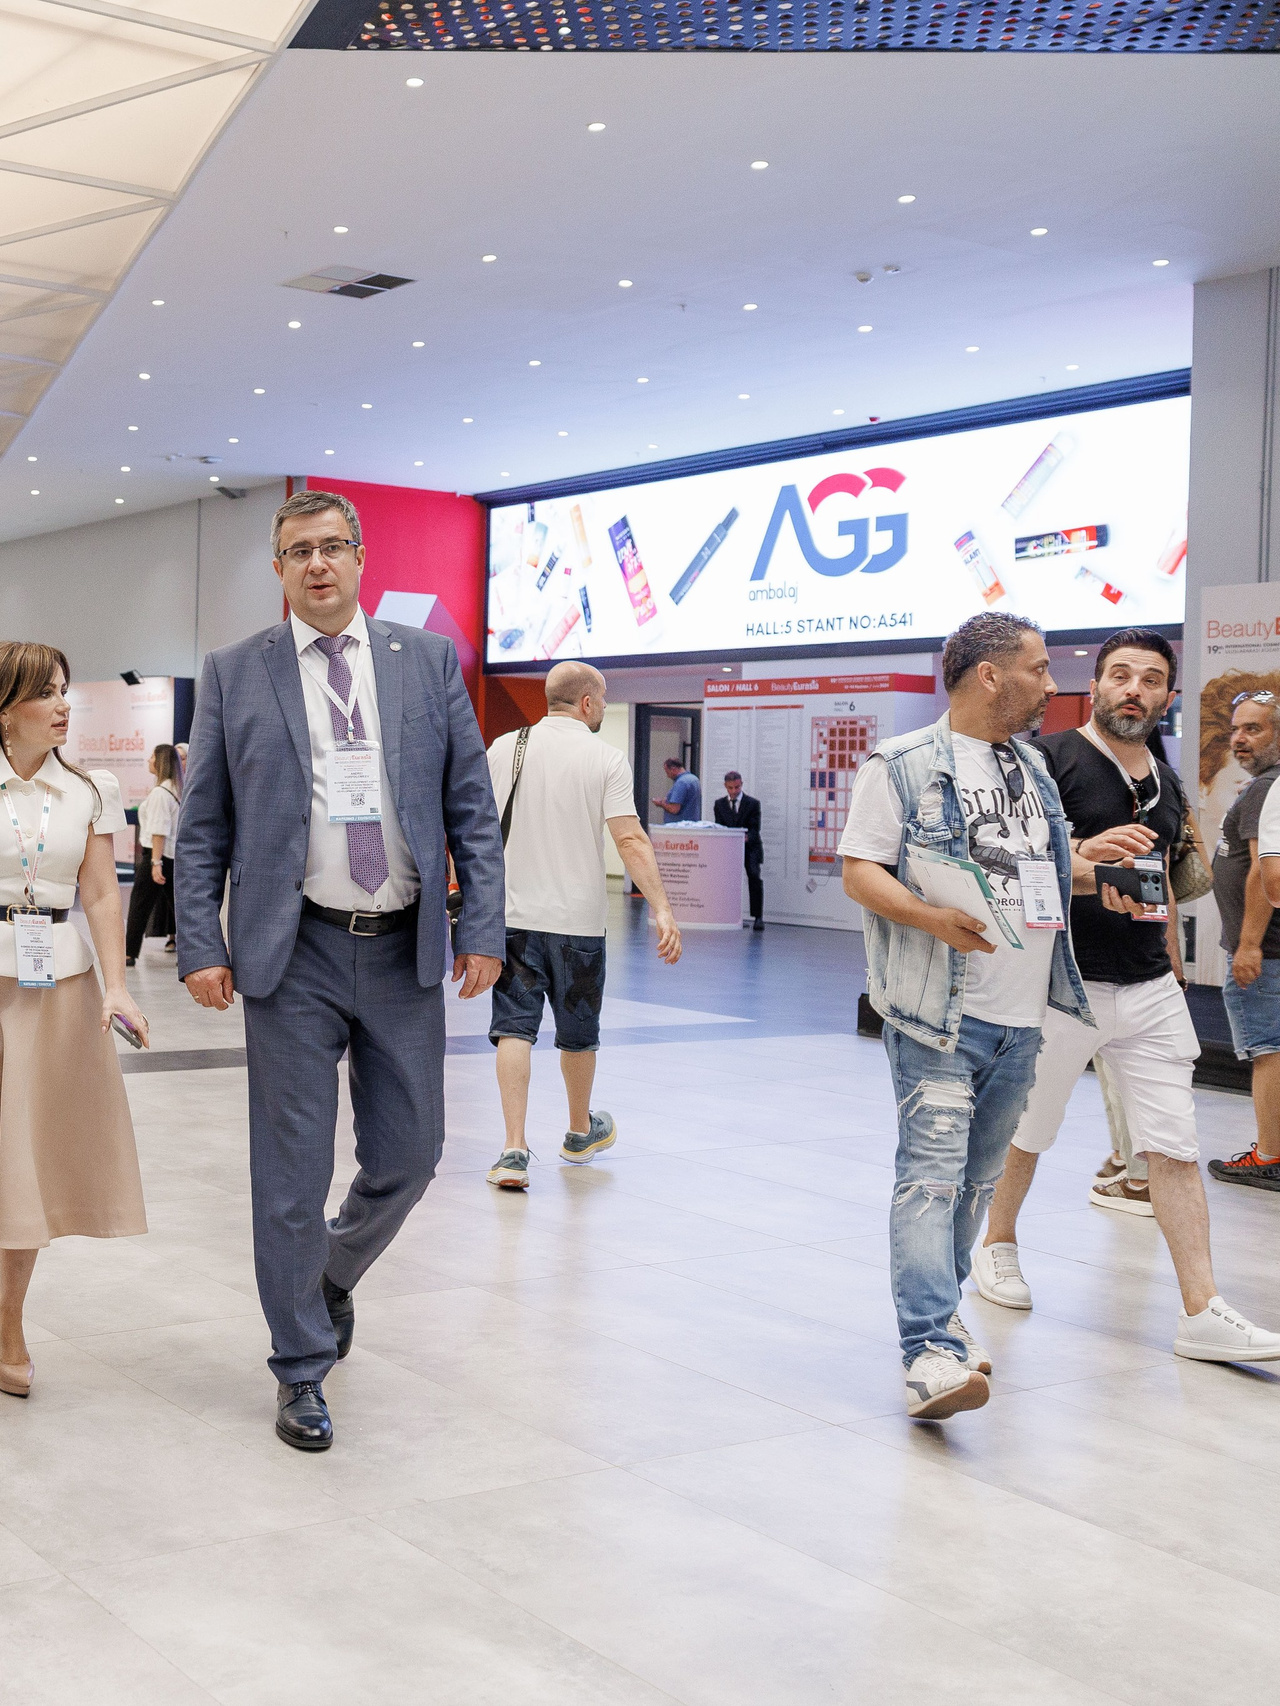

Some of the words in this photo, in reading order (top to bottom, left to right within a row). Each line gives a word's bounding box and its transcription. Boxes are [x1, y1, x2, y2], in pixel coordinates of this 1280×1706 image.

[750, 467, 909, 581] AGG
[746, 620, 792, 636] HALL:5
[796, 617, 844, 634] STANT
[849, 612, 913, 630] NO:A541
[707, 684, 730, 693] SALON
[736, 683, 753, 691] HALL
[754, 683, 759, 691] 6
[771, 680, 819, 691] BeautyEurasia
[849, 701, 856, 711] 6
